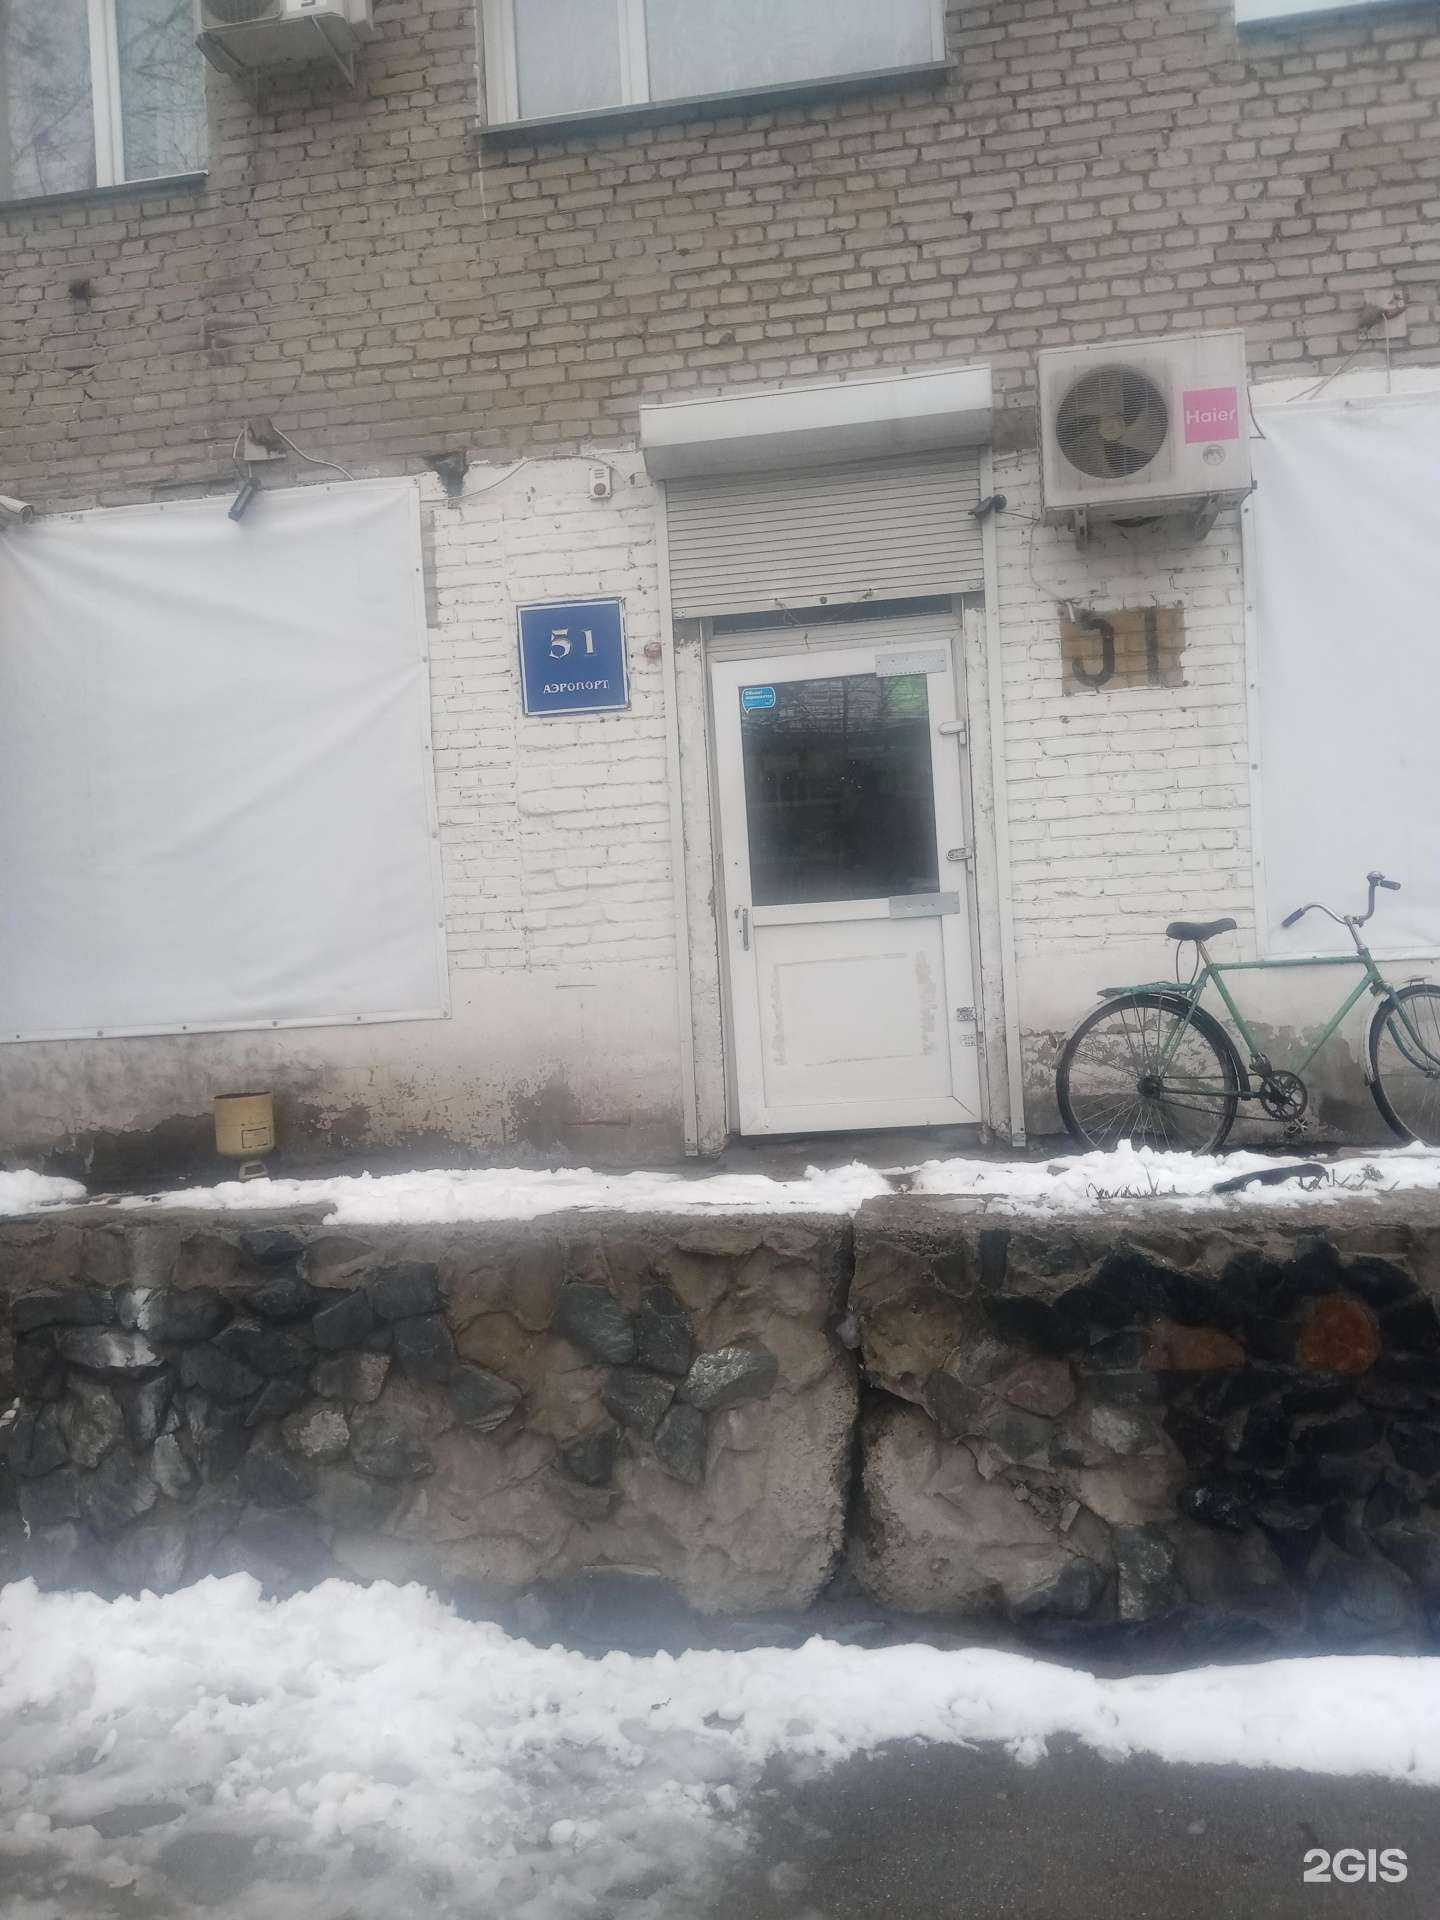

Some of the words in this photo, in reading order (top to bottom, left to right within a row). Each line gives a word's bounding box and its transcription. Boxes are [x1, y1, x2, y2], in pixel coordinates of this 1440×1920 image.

[1186, 408, 1236, 424] Haier
[549, 627, 594, 660] 51
[543, 680, 609, 694] АЭРОПОРТ
